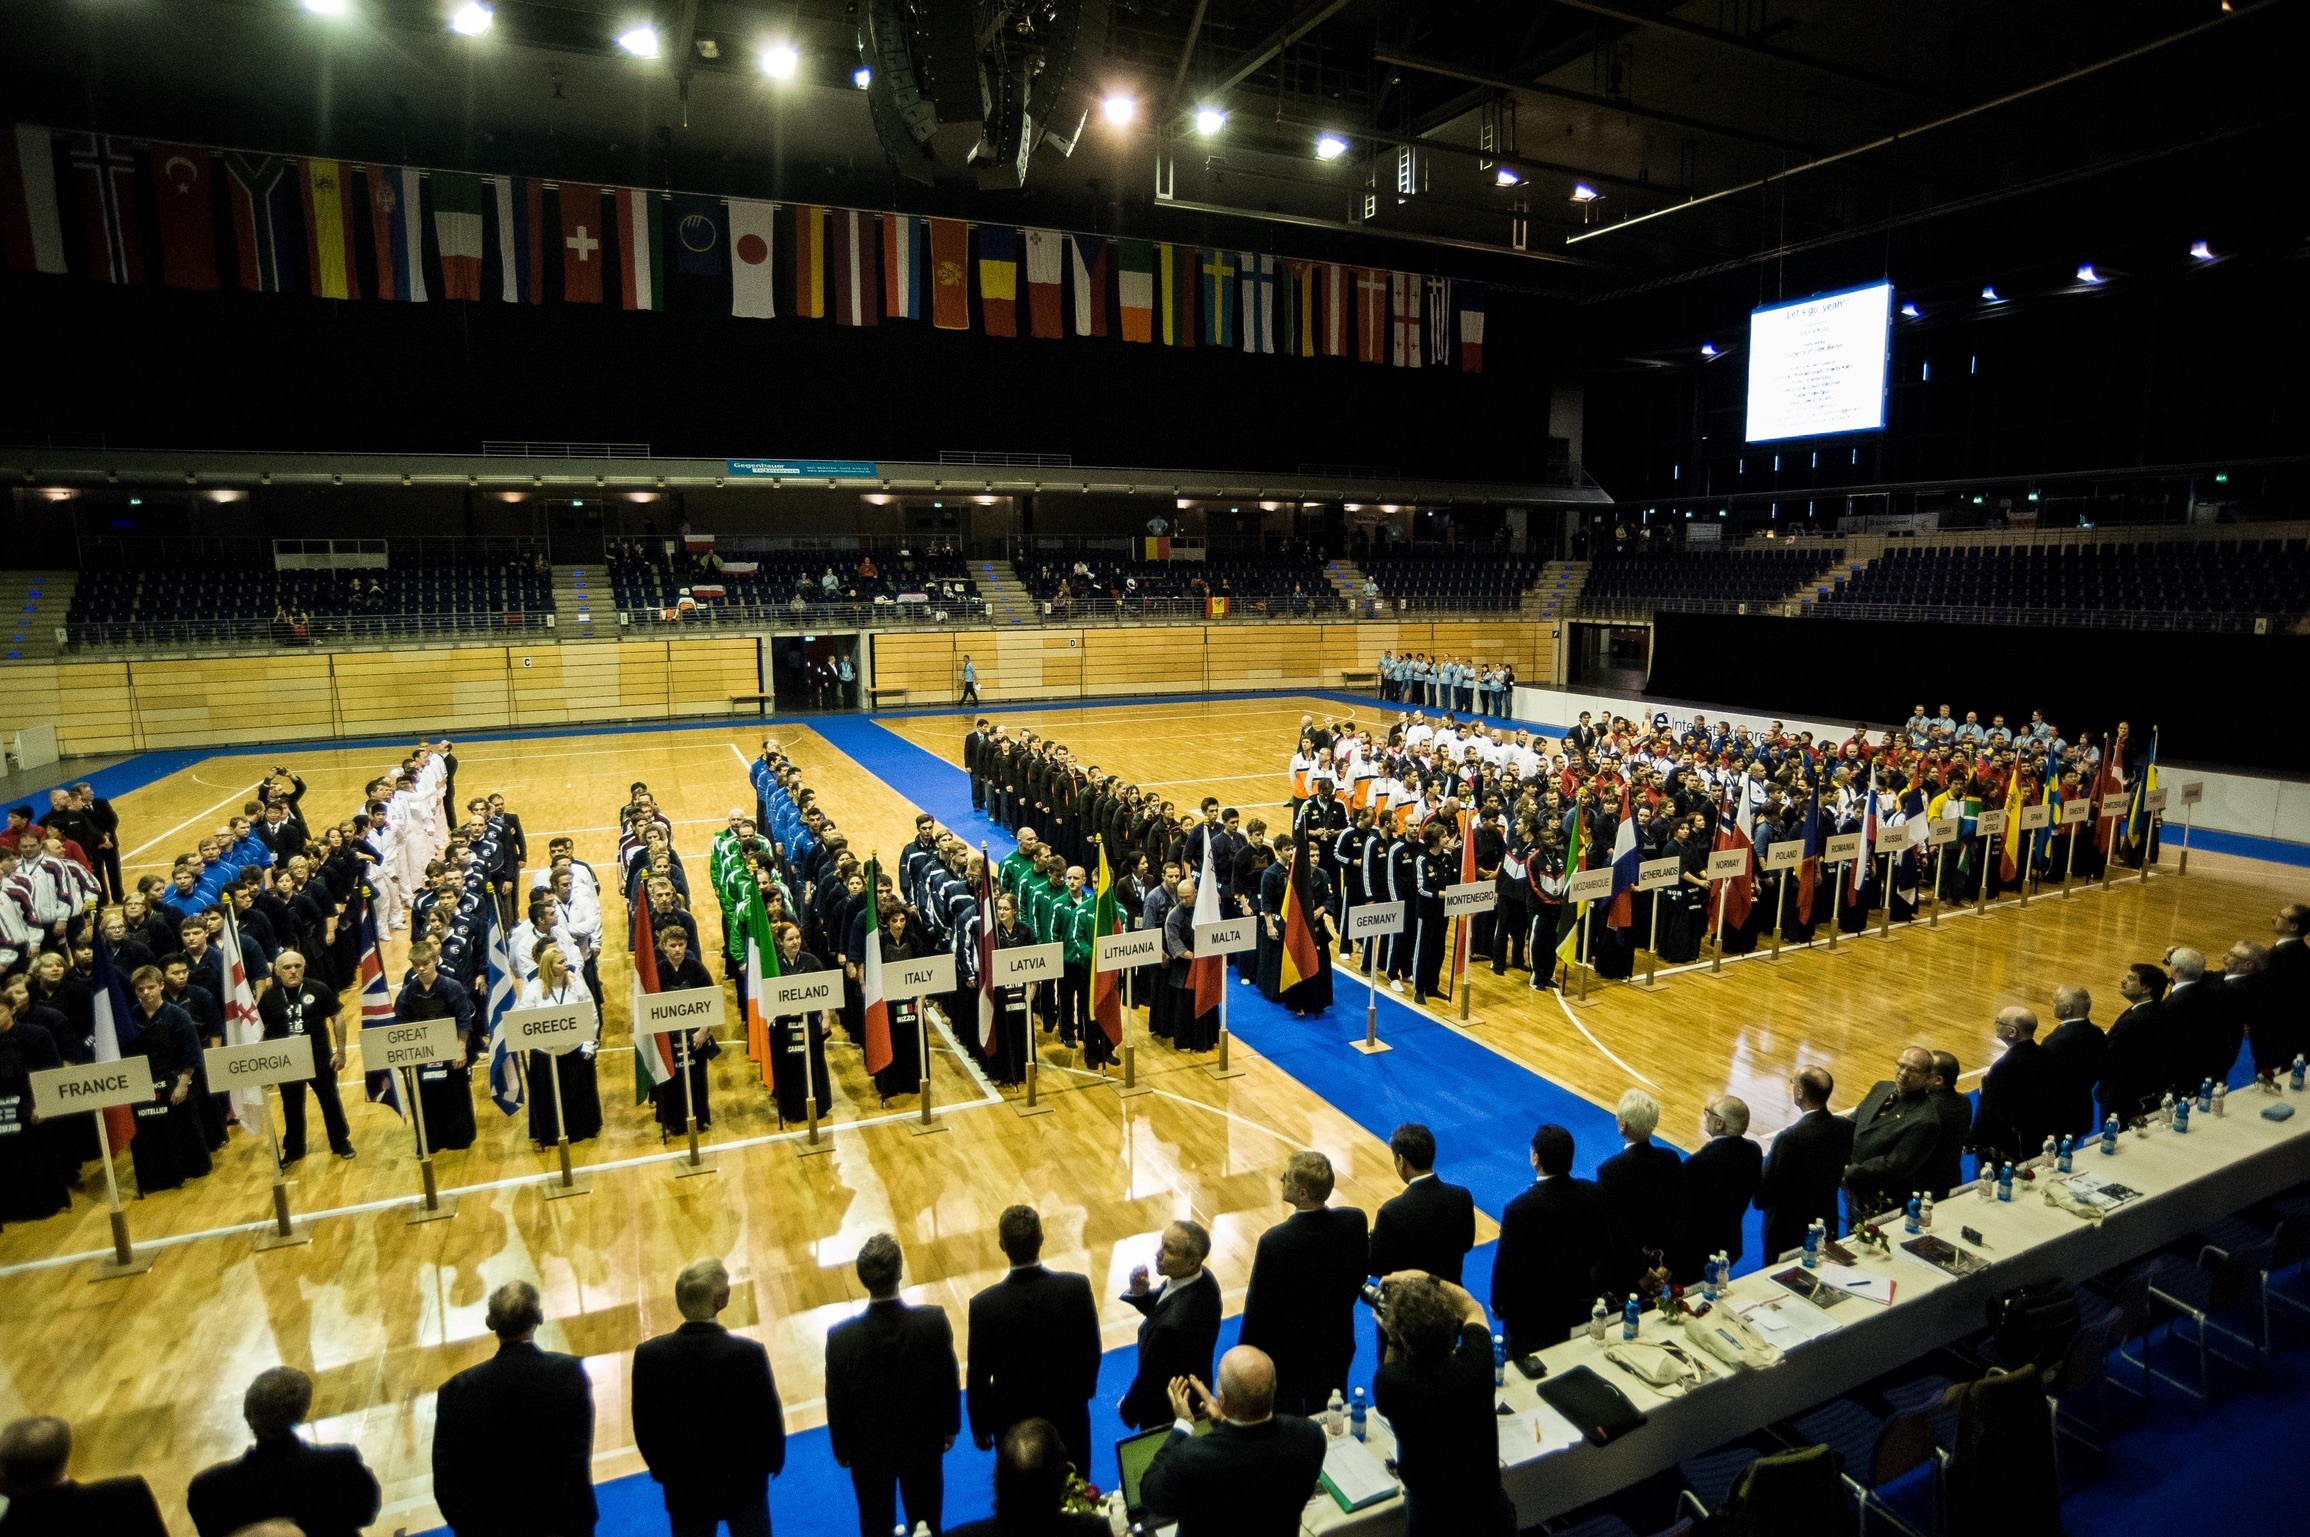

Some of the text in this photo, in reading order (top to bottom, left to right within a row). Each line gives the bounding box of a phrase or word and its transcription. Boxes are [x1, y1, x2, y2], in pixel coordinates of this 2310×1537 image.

[1070, 639, 1076, 647] D
[524, 658, 531, 667] C
[1671, 717, 1718, 736] Inteet
[1985, 812, 2000, 822] SOUTH
[2030, 813, 2043, 821] SPAIN
[2068, 807, 2085, 816] SWEDEN
[1936, 826, 1952, 836] SERBIA
[1983, 823, 1999, 832] AFRICA
[1884, 834, 1903, 844] RUSSIA
[1831, 842, 1855, 853] ROMANIA
[1775, 850, 1798, 861] POLAND
[1715, 858, 1740, 870] NORWAY
[1639, 866, 1679, 881] NETHERLANDS
[1572, 878, 1610, 892] MOZAMBIQUE
[1446, 890, 1494, 906] MONTENEGRO
[1356, 912, 1398, 928] GERMANY
[1211, 931, 1241, 945] MALTA
[1104, 940, 1155, 960] LITHUANIA
[1010, 956, 1046, 972] LATVIA
[904, 969, 934, 985] ITALY
[778, 984, 829, 1002] IRELAND
[650, 1000, 712, 1020] HUNGARY
[522, 1016, 578, 1036] GREECE
[387, 1026, 428, 1044] GREAT
[387, 1045, 435, 1063] BRITAIN
[228, 1054, 292, 1075] GEORGIA
[58, 1074, 130, 1099] FRANCE
